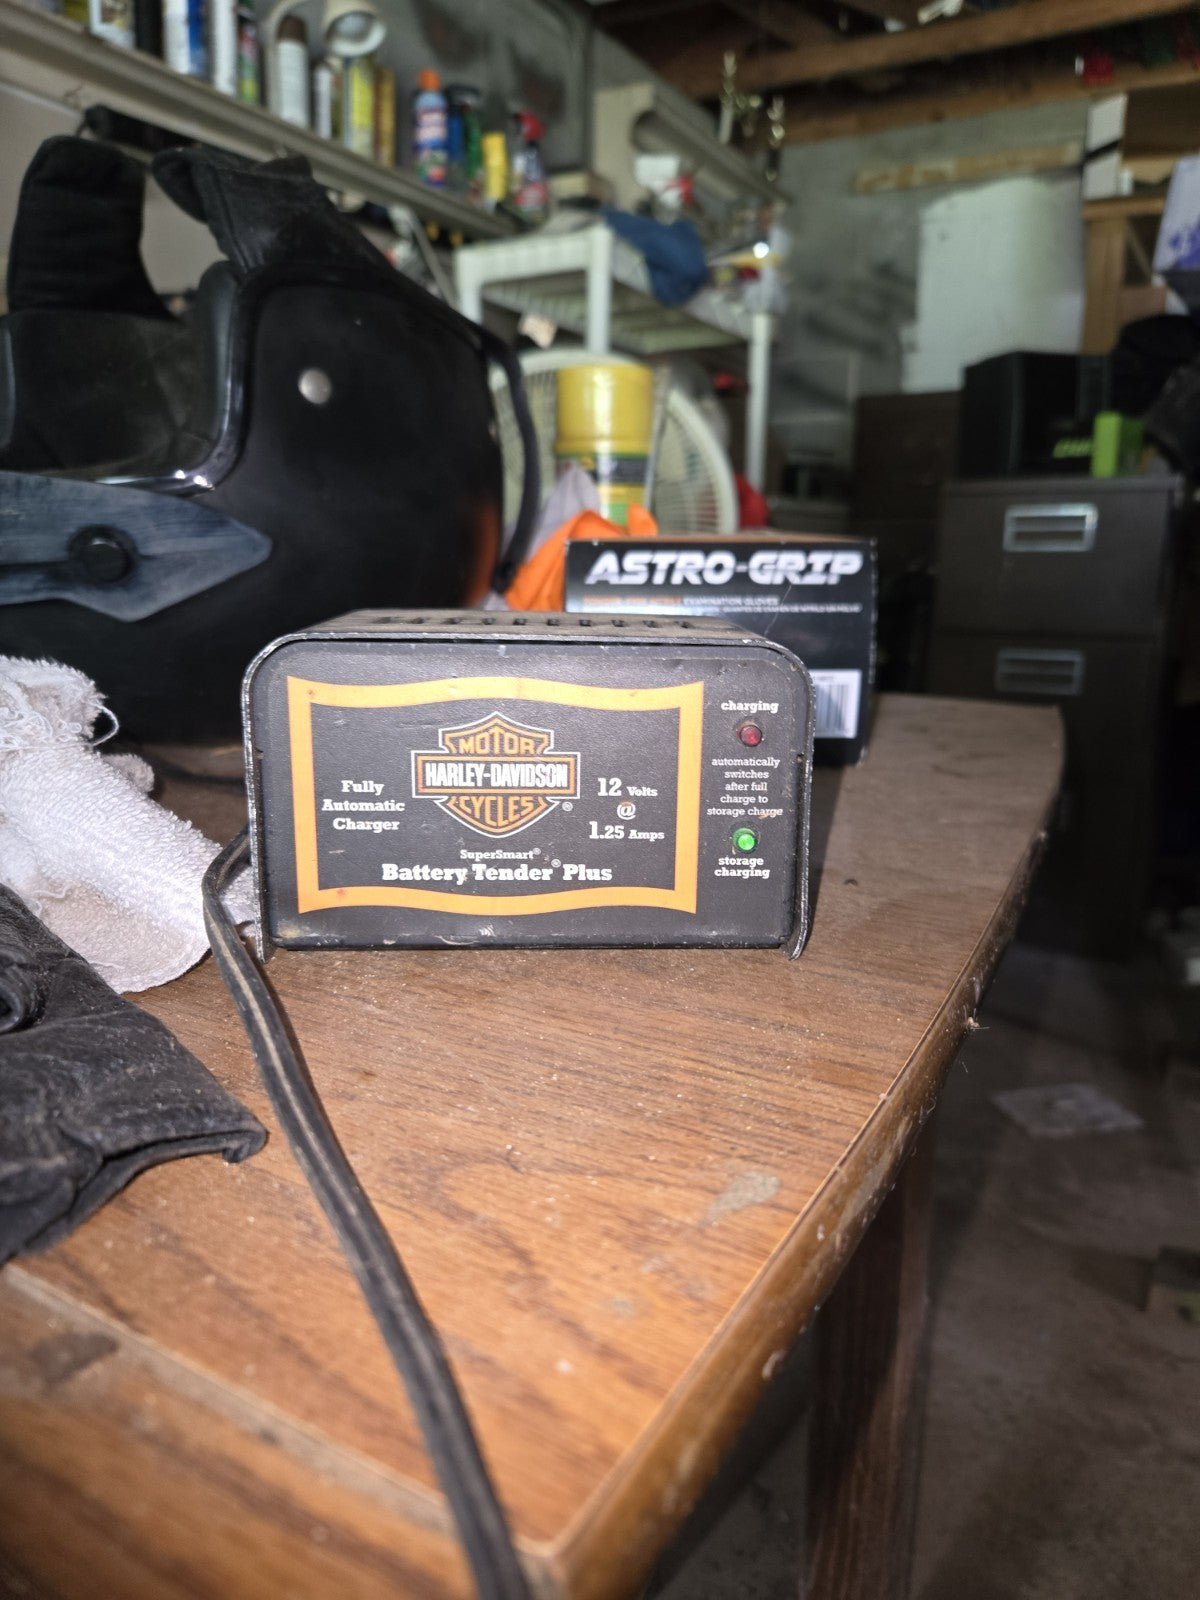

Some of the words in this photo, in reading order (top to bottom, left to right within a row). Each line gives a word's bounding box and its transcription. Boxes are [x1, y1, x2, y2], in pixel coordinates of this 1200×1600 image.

[585, 550, 863, 585] ASTRO-GRIP
[721, 700, 779, 714] charging
[458, 725, 536, 755] MOTOR
[711, 757, 780, 768] automatically
[425, 763, 568, 788] HARLEY-DAVIDSON
[724, 770, 770, 779] switches
[341, 780, 385, 796] Fully
[597, 777, 622, 797] 12
[626, 786, 659, 797] Volts
[725, 782, 750, 791] after
[751, 782, 768, 791] full
[321, 799, 406, 812] Automatic
[720, 794, 756, 805] charge
[758, 795, 769, 804] to
[459, 796, 531, 827] CYCLES
[616, 801, 637, 820] @
[706, 807, 746, 817] storage
[747, 807, 784, 818] charge
[332, 818, 400, 833] Charger
[588, 820, 625, 839] 1.25
[627, 829, 665, 842] Amps
[718, 856, 765, 867] storage
[381, 863, 468, 885] Battery
[562, 863, 613, 881] Plus
[714, 867, 771, 879] charging
